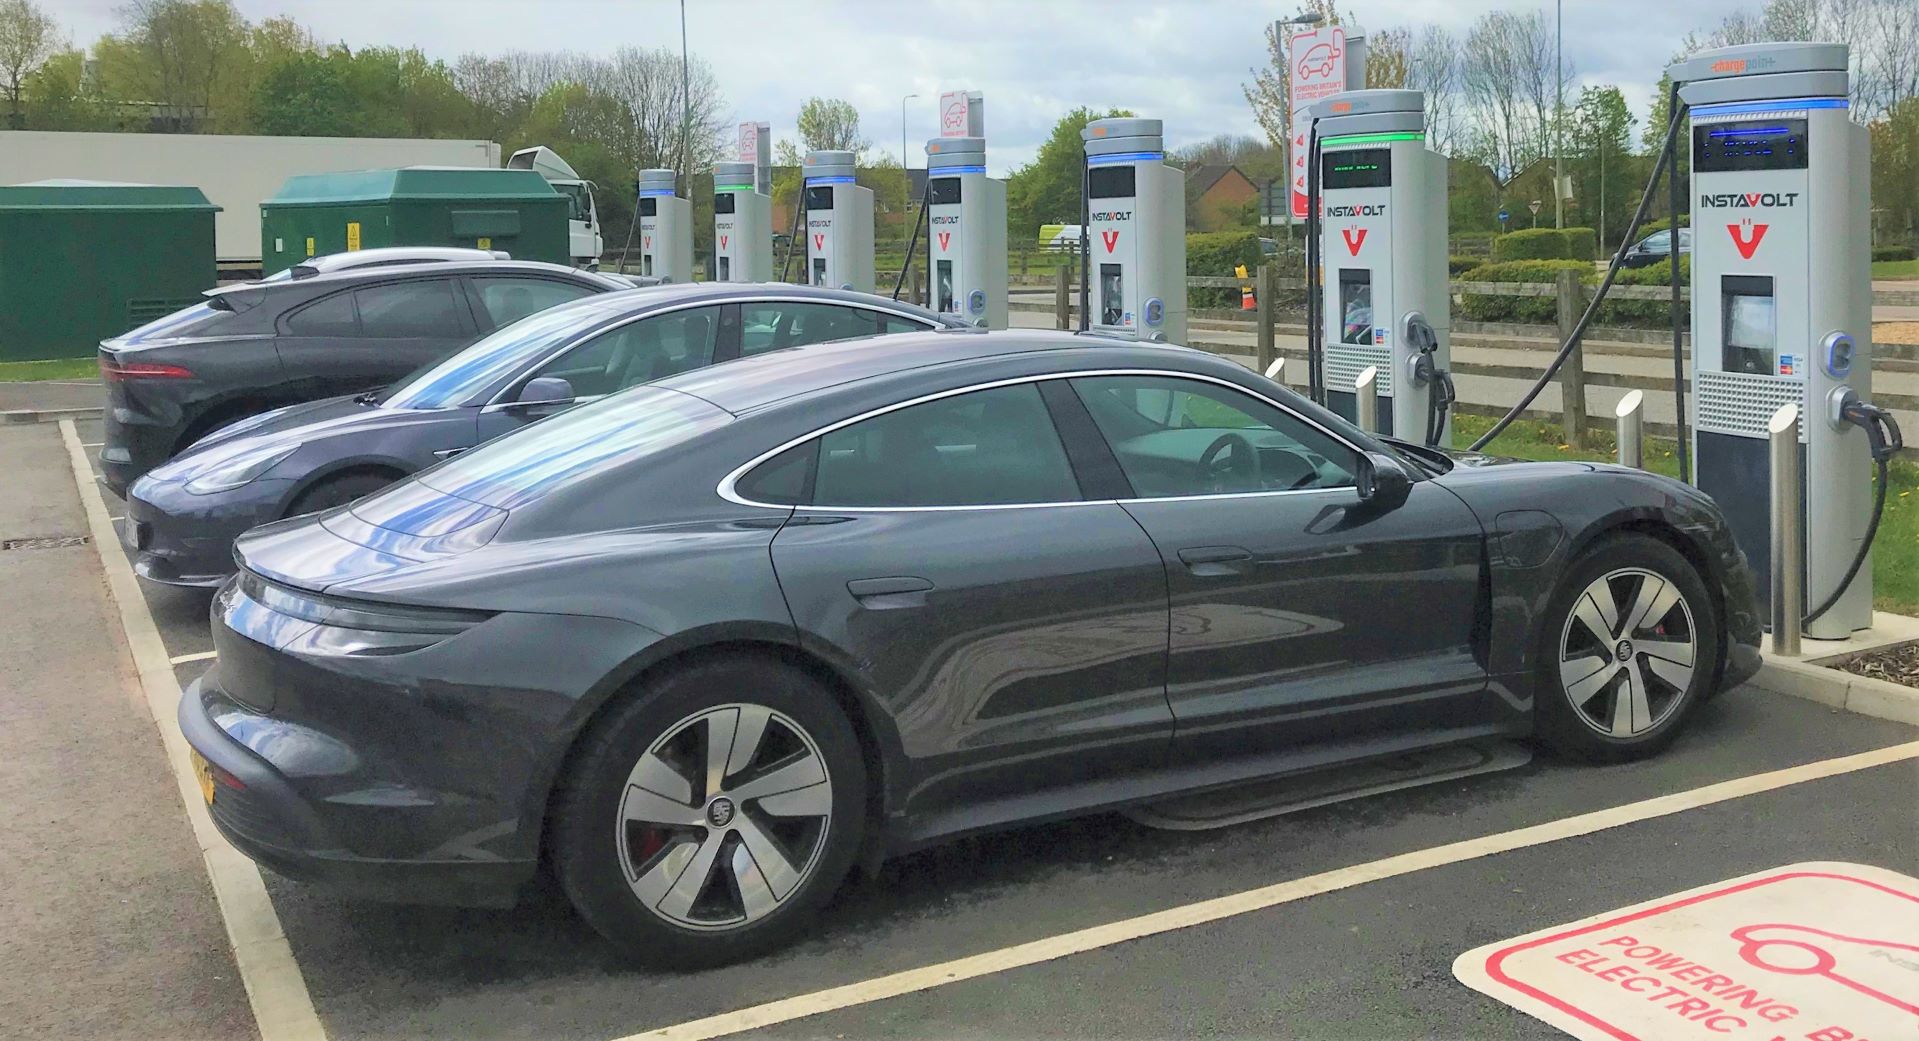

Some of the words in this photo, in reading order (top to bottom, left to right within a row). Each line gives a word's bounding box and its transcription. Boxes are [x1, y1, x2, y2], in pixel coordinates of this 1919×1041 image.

[1327, 205, 1386, 217] INSTAVOLT
[1701, 193, 1799, 208] INSTAVOLT
[1555, 949, 1748, 1033] ELECTRIC
[1598, 935, 1799, 1022] POWERING
